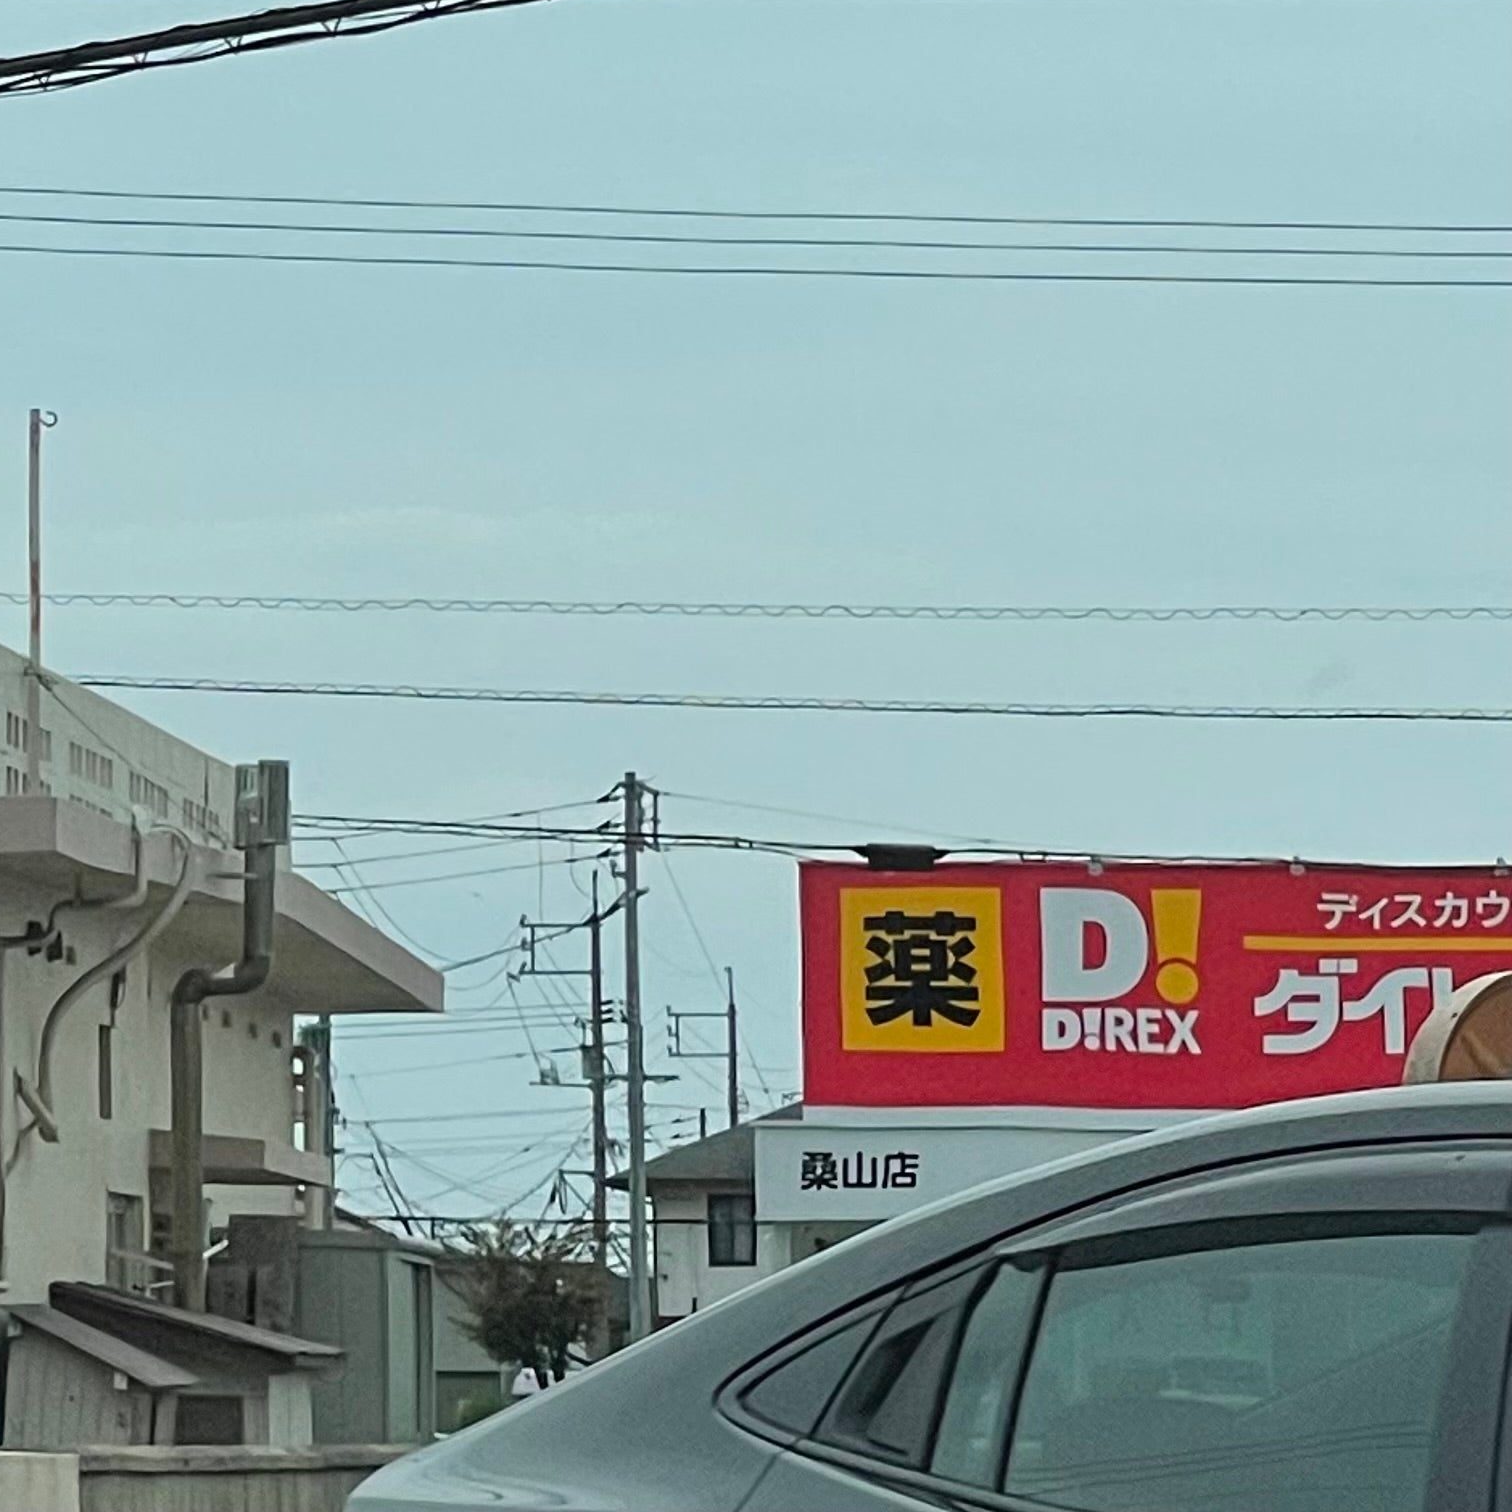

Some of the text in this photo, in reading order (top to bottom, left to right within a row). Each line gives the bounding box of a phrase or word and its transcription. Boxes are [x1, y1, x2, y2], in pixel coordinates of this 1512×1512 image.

[862, 911, 982, 1027] 薬
[801, 1151, 920, 1191] 桑山店
